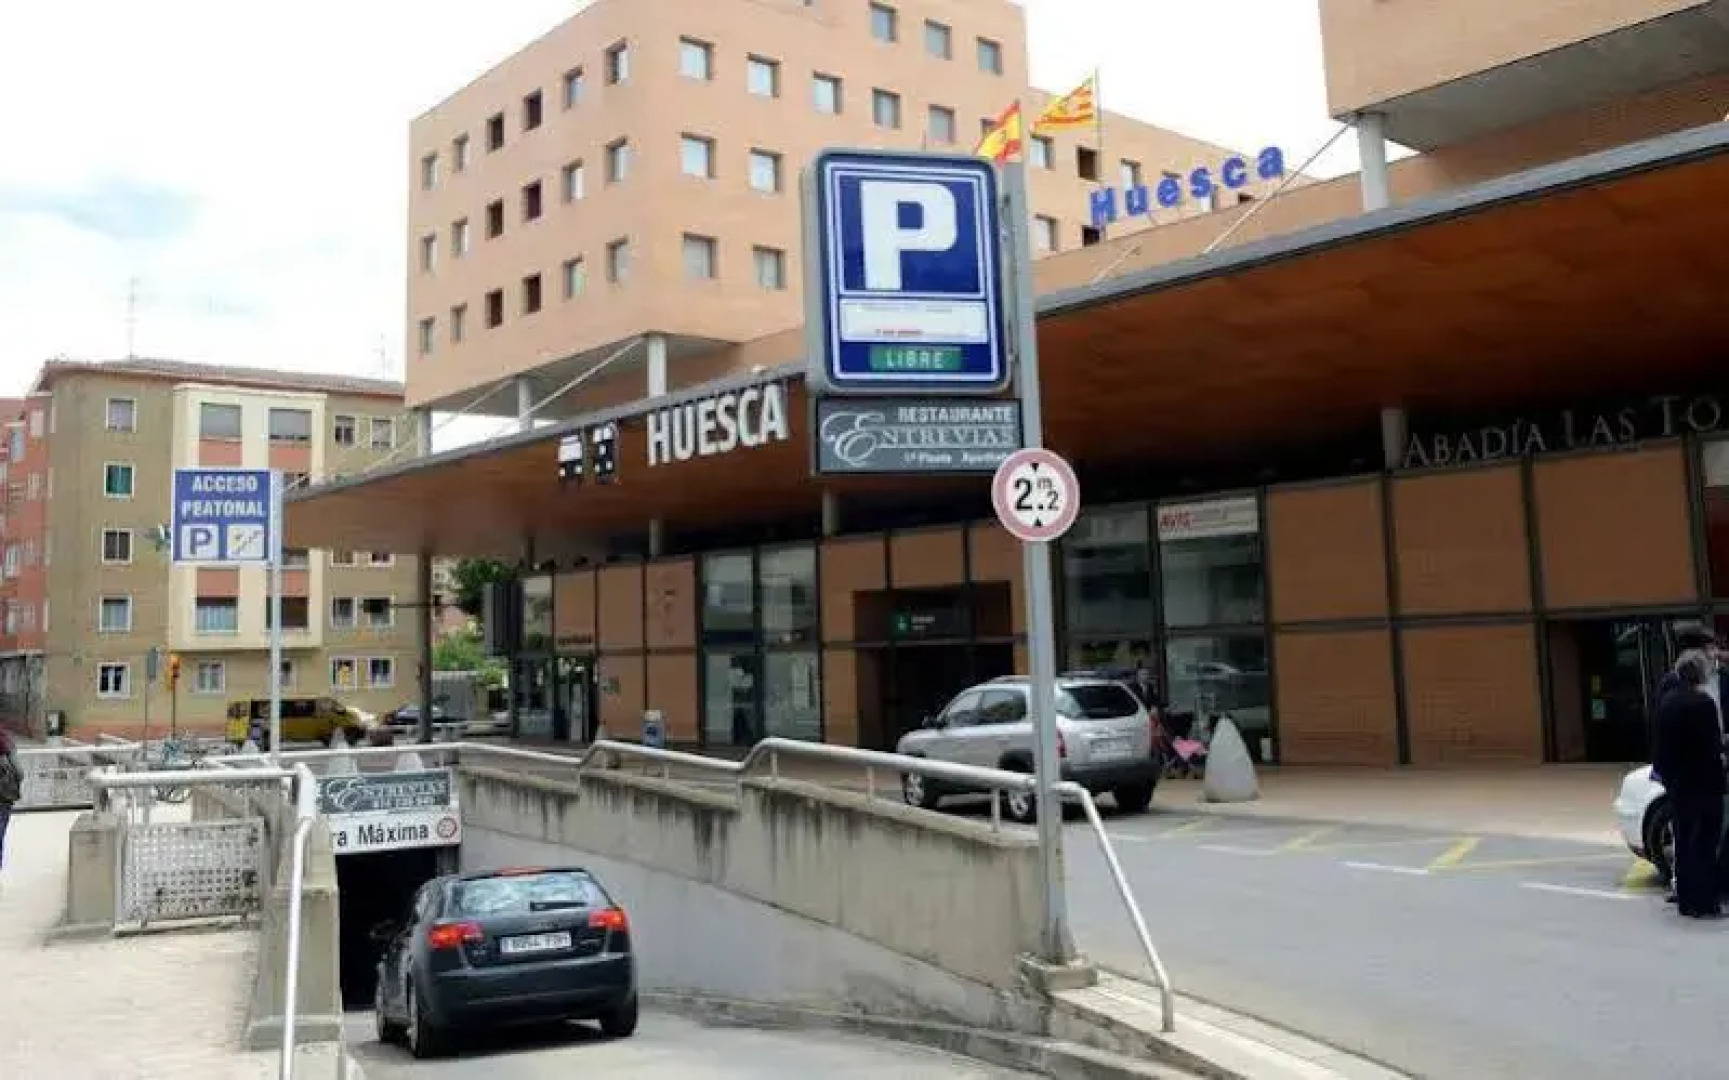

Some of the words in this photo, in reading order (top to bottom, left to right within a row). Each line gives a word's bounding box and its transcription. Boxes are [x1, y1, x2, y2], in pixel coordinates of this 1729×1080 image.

[1090, 146, 1284, 228] Huesca
[860, 180, 957, 290] P
[886, 350, 945, 369] LIBRE
[647, 384, 788, 467] HUESCA
[898, 406, 1014, 422] RESTAURANTE
[820, 411, 1014, 467] ENTREVIAS
[1403, 417, 1548, 469] ABADÍA
[1558, 408, 1636, 448] LAS
[192, 475, 259, 493] ACCESO
[182, 500, 267, 518] PEATONAL
[190, 527, 213, 555] P
[358, 822, 430, 845] Máxima
